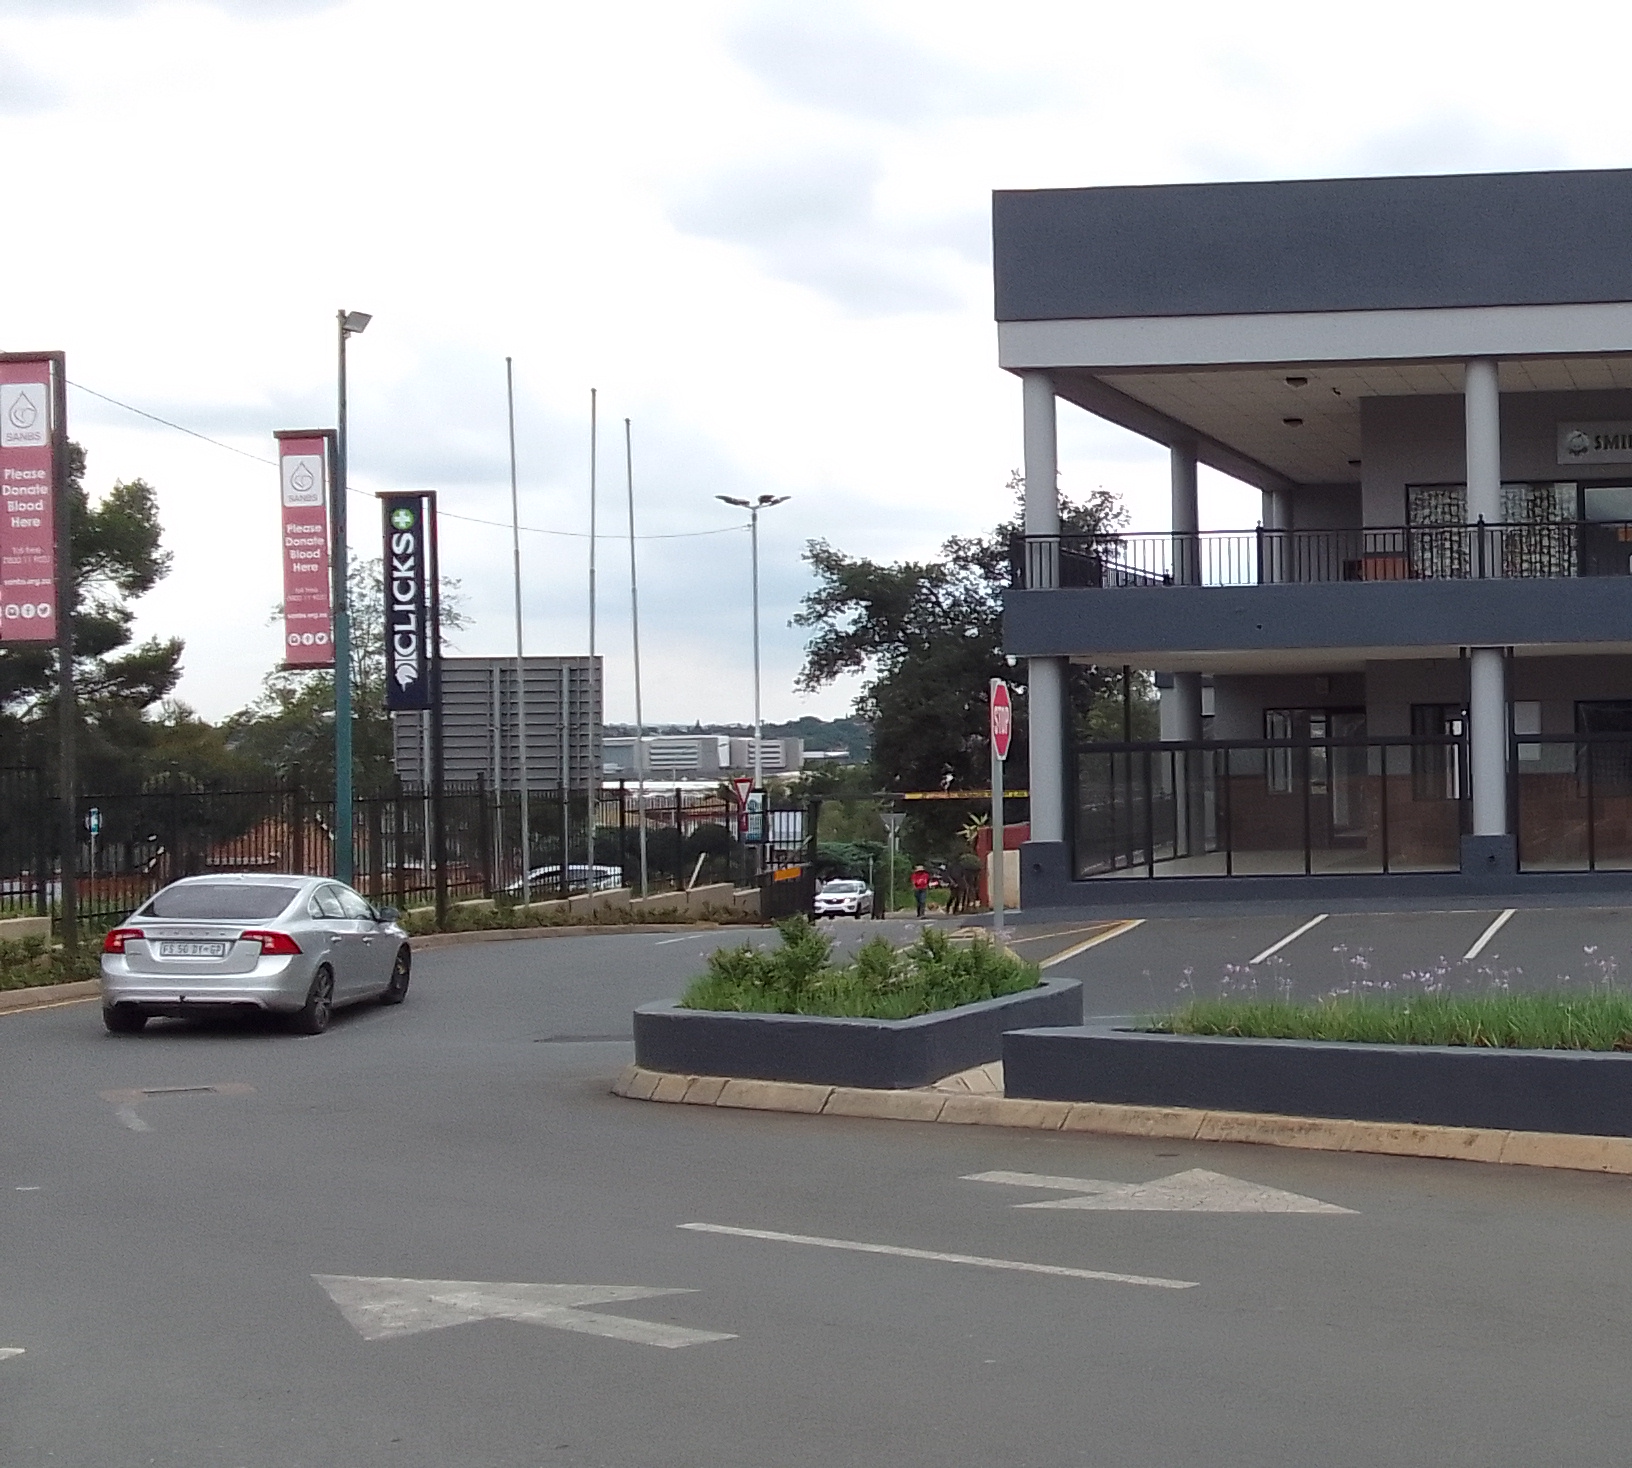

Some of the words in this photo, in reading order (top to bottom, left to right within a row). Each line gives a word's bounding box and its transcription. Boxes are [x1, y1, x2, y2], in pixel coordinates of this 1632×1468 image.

[6, 432, 42, 441] SANBS
[4, 468, 47, 480] Please
[2, 484, 49, 496] Donate
[7, 500, 44, 512] Blood
[11, 516, 41, 528] Here
[286, 523, 322, 534] Please
[285, 536, 325, 547] Donate
[289, 549, 321, 560] Blood
[293, 562, 319, 573] Here
[391, 532, 417, 658] CLICKS
